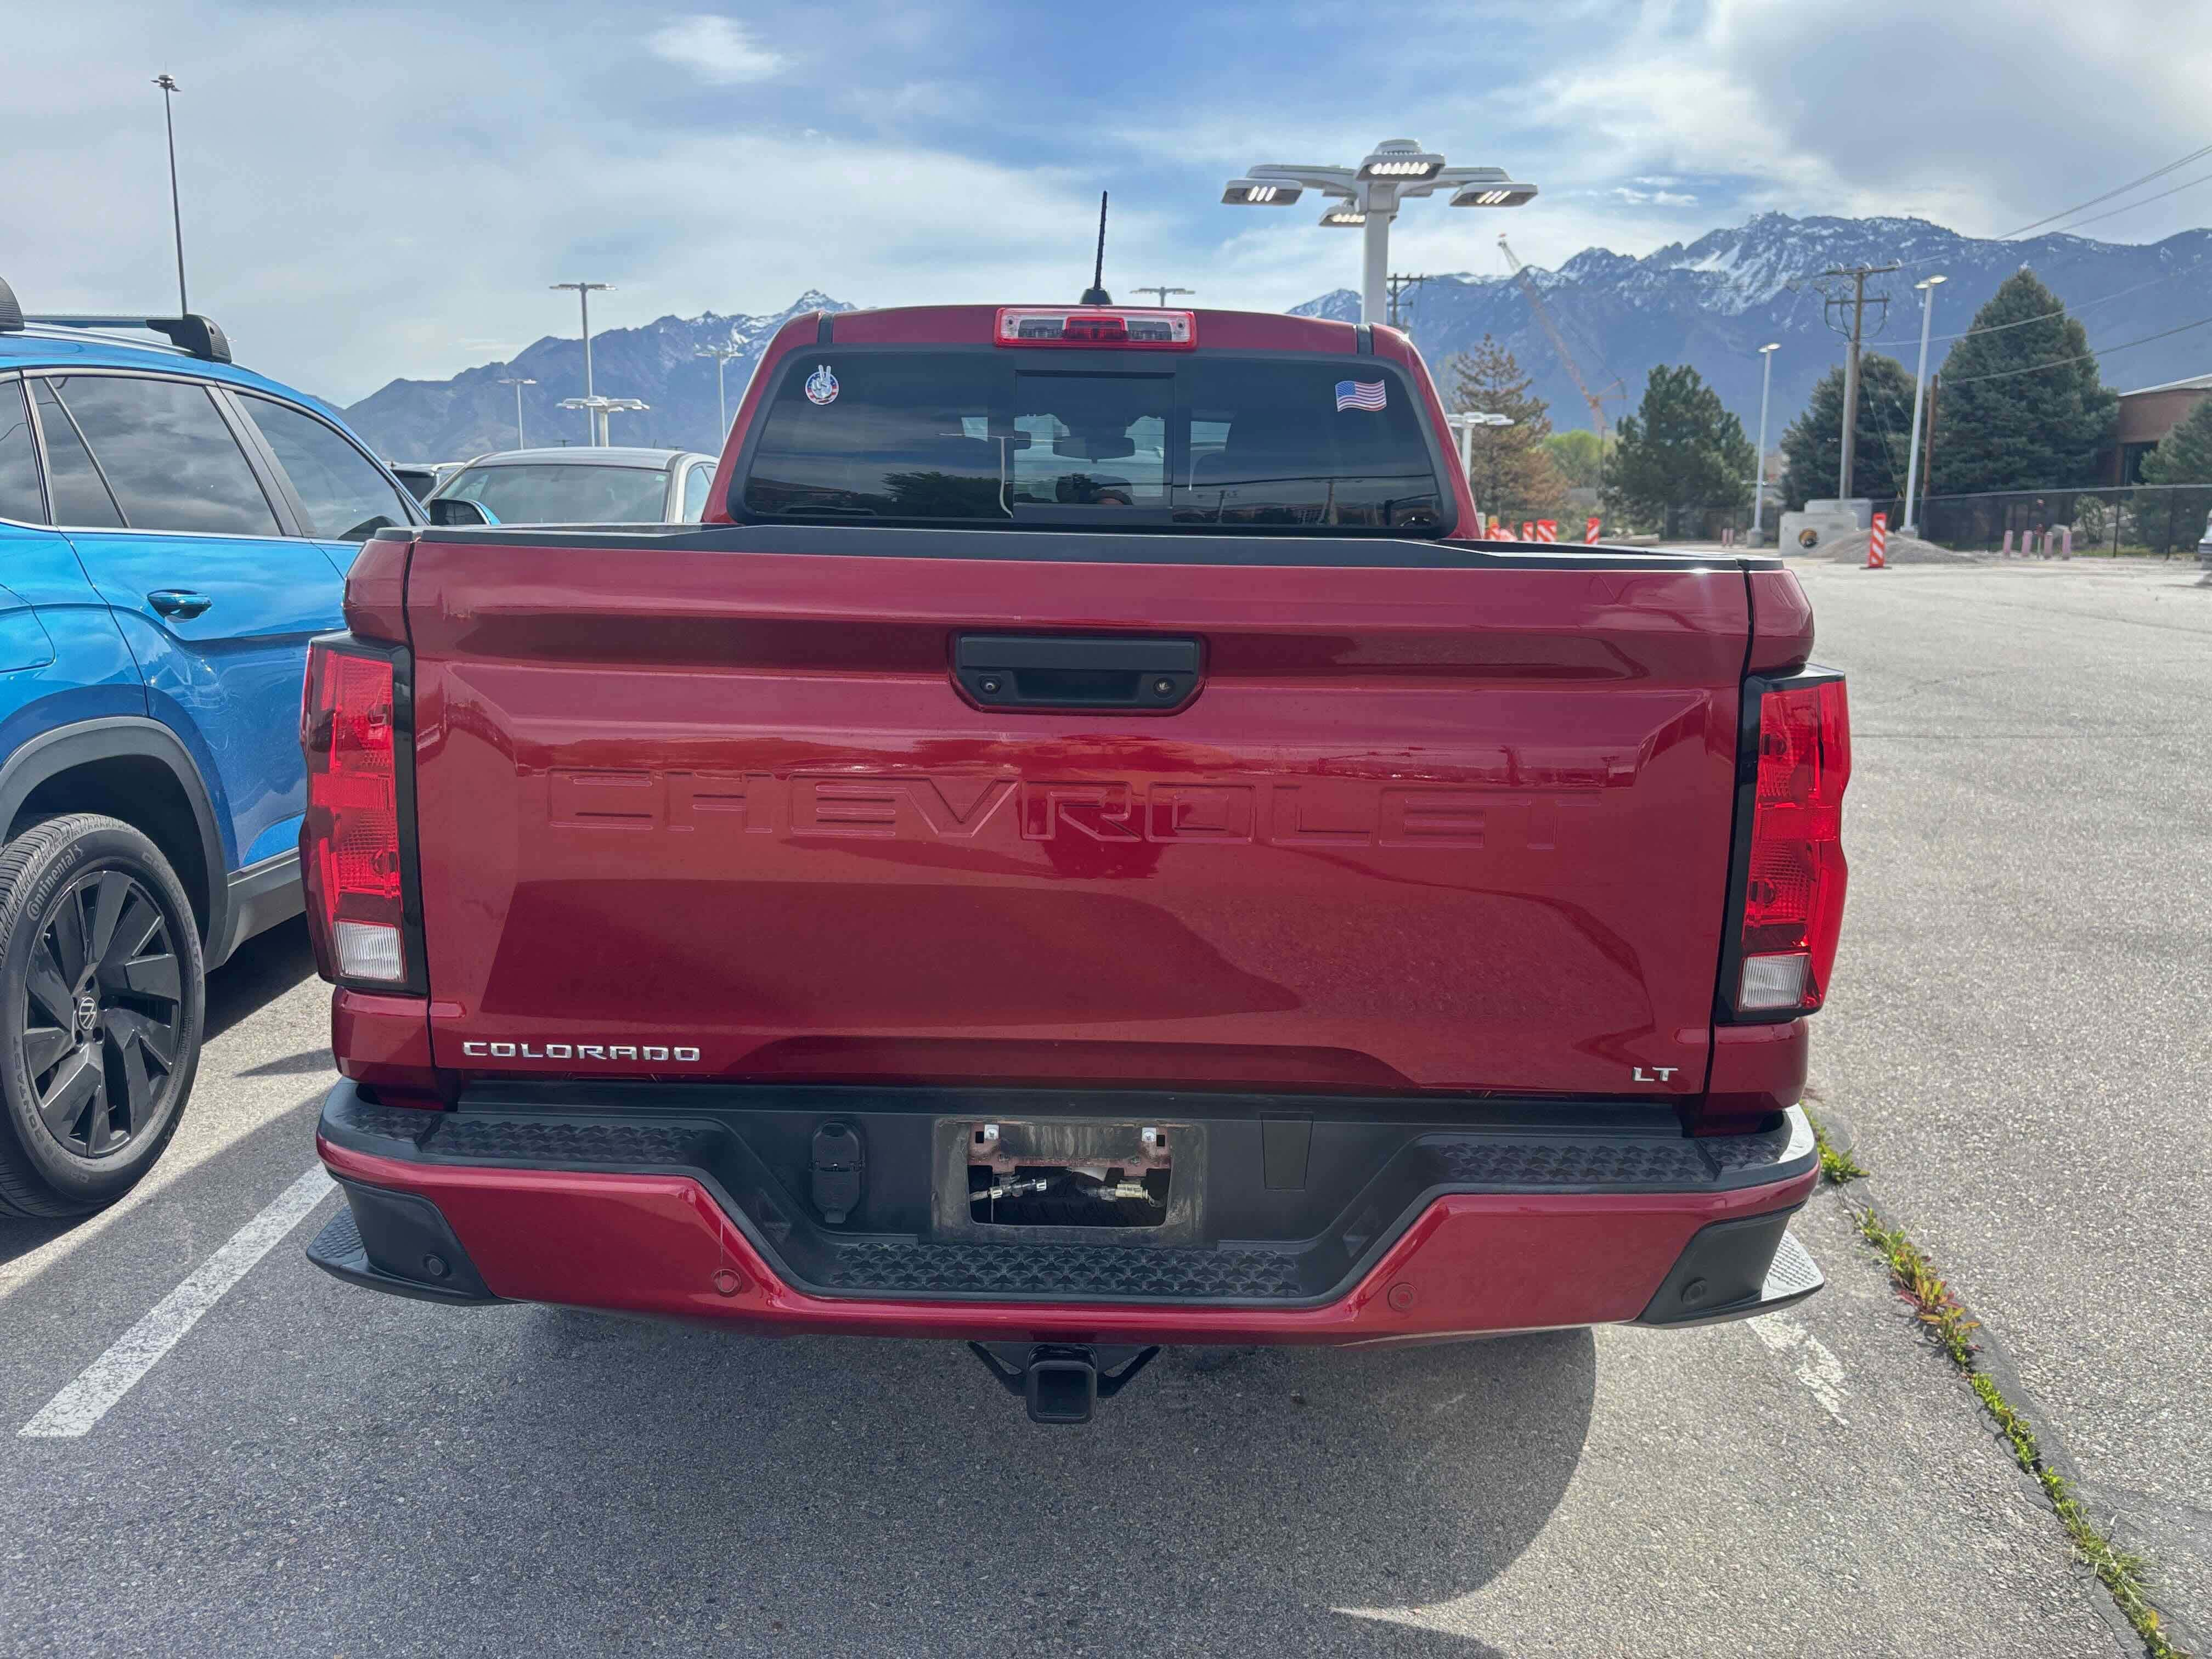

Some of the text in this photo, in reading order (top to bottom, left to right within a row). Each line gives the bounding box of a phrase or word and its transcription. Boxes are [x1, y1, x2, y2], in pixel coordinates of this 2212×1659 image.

[549, 769, 1602, 850] CHEVROLET
[27, 848, 76, 921] Continental
[462, 1042, 700, 1062] COLORADO
[1633, 1066, 1679, 1082] LT
